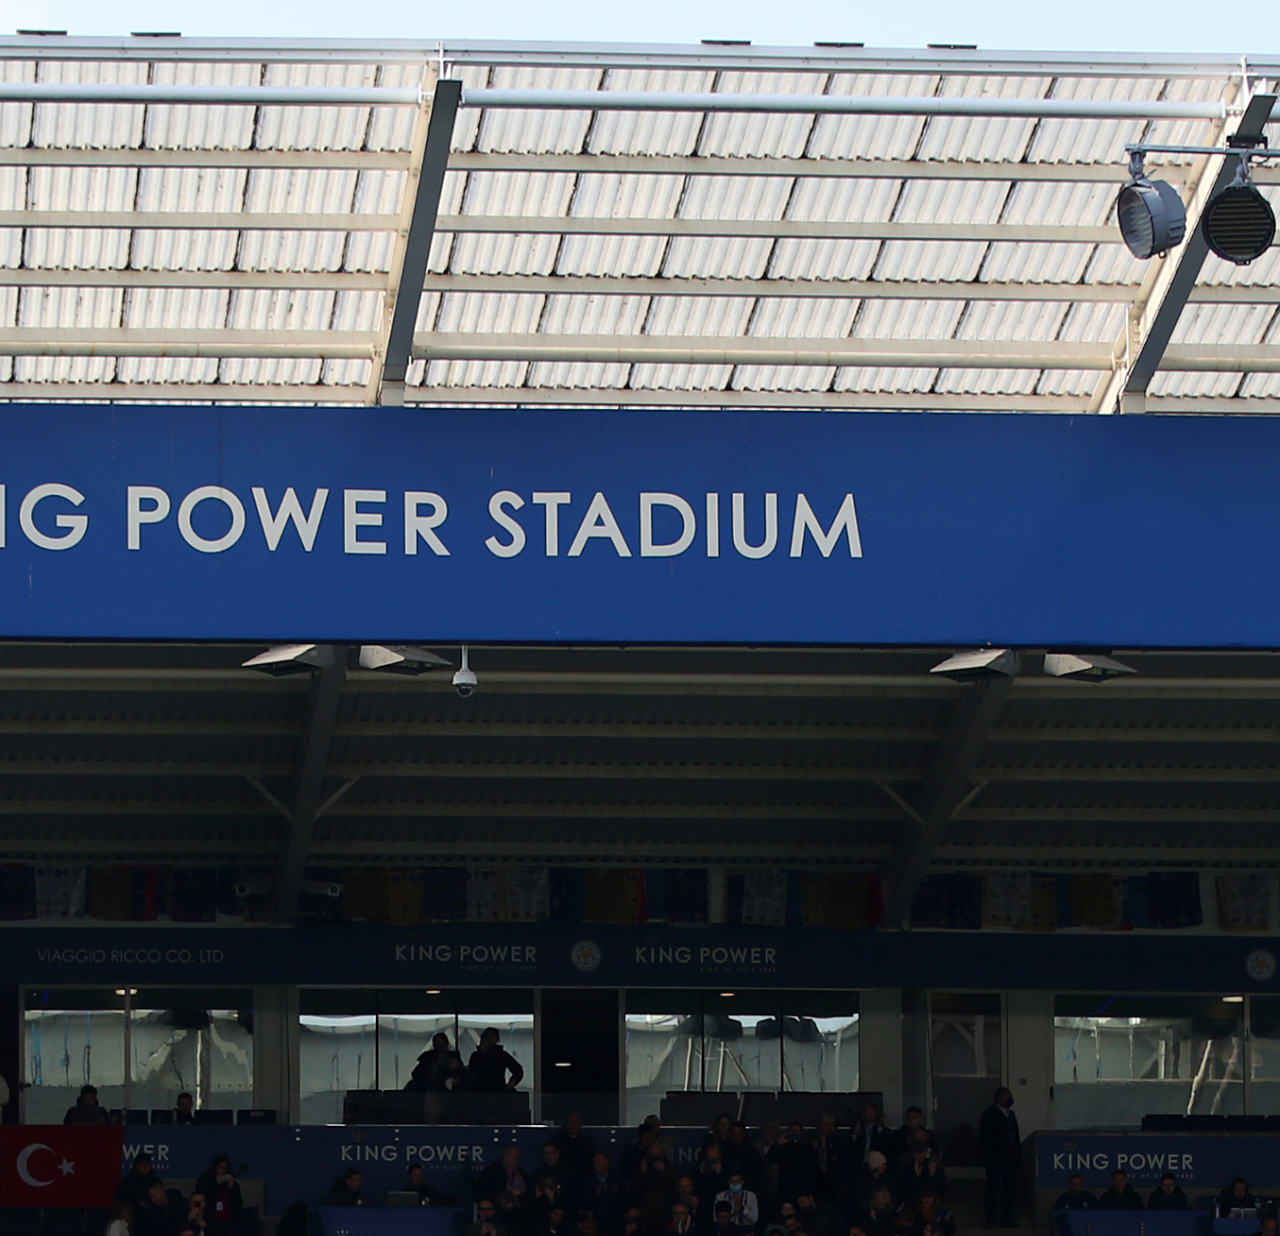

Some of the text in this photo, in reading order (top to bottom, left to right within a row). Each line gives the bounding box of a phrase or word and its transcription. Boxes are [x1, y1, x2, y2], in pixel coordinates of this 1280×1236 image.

[127, 486, 451, 557] POWER
[486, 490, 863, 561] STADIUM
[37, 949, 106, 963] VIAGGIO
[110, 949, 161, 963] RICCO
[199, 949, 224, 963] LTD
[395, 945, 537, 962] KING POWER
[635, 946, 776, 964] KING POWER
[121, 1144, 169, 1160] WER
[341, 1145, 483, 1161] KING POWER
[1053, 1153, 1193, 1170] KING POWER
